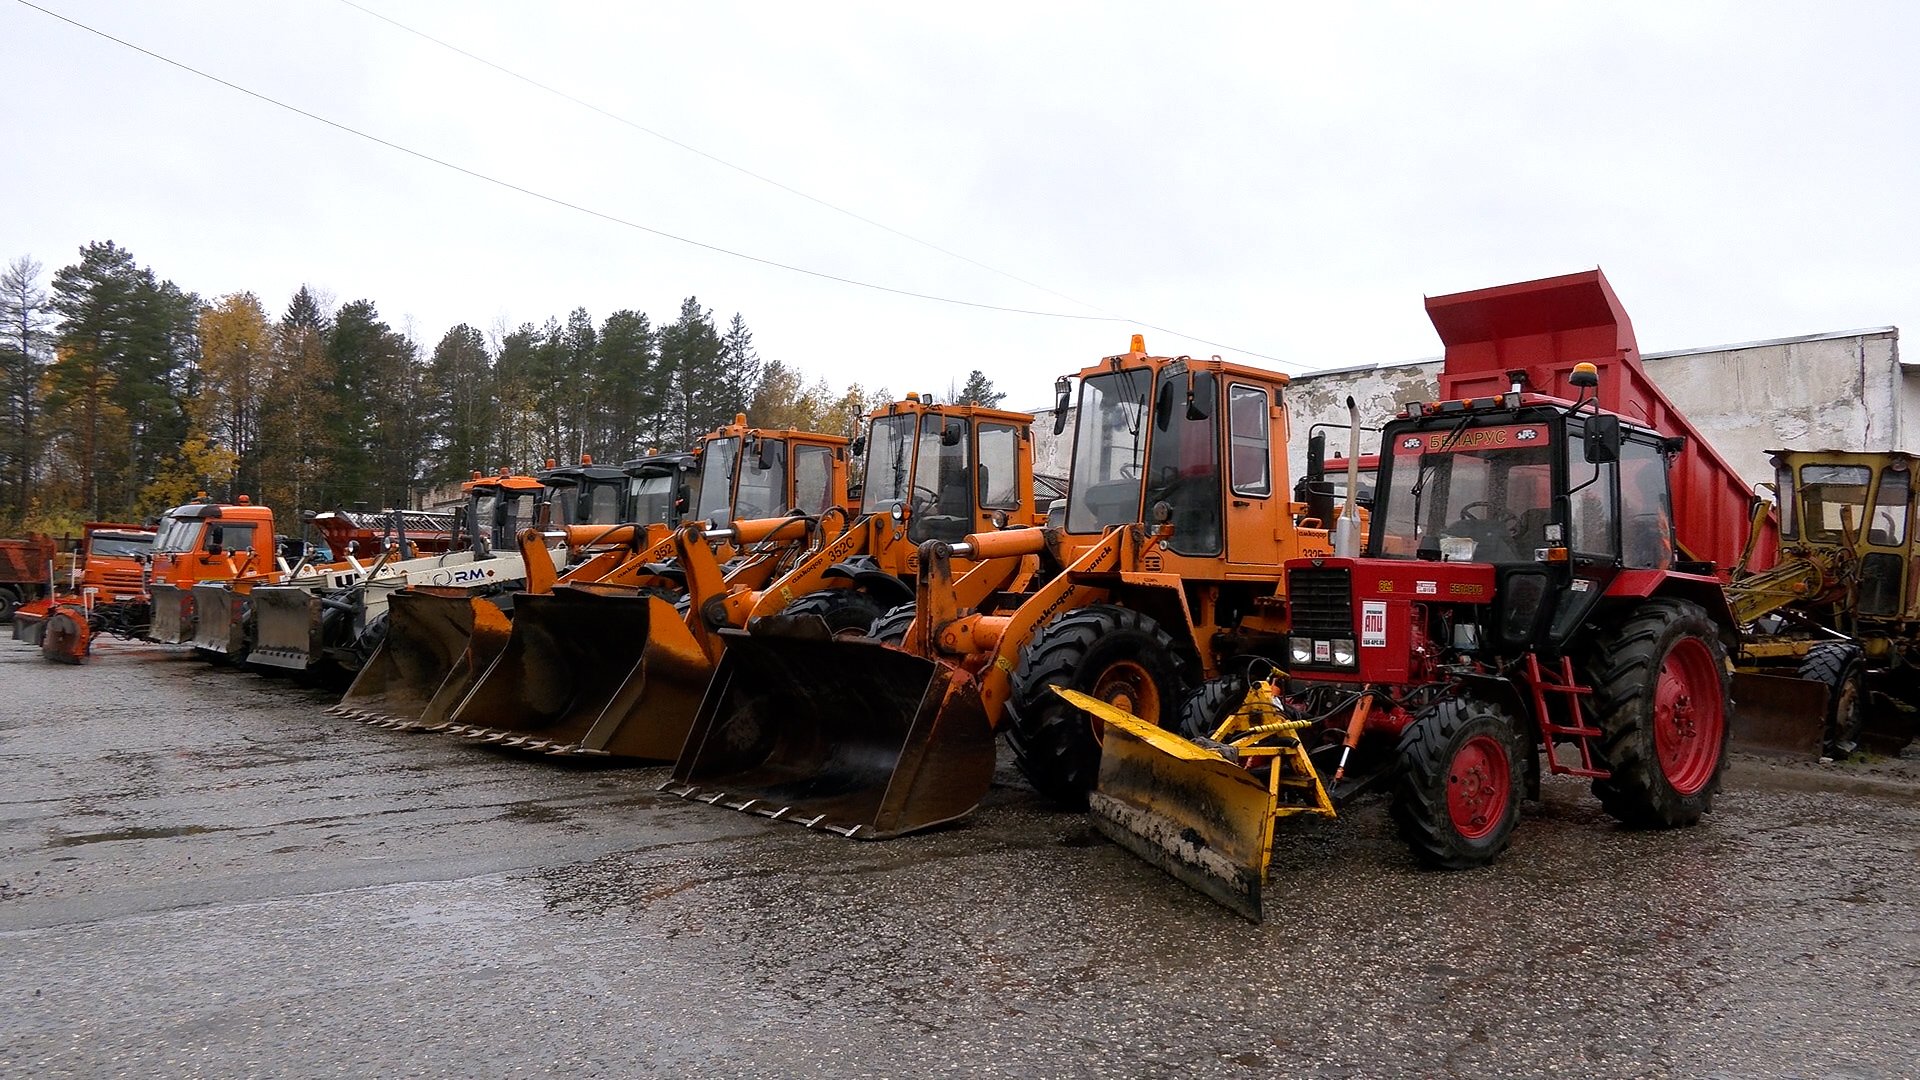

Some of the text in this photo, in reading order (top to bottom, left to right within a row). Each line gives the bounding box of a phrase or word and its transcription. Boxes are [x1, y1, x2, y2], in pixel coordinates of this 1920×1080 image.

[1430, 431, 1506, 449] БЕЛАРУС
[654, 543, 673, 560] 352
[1365, 615, 1383, 632] АПЦ
